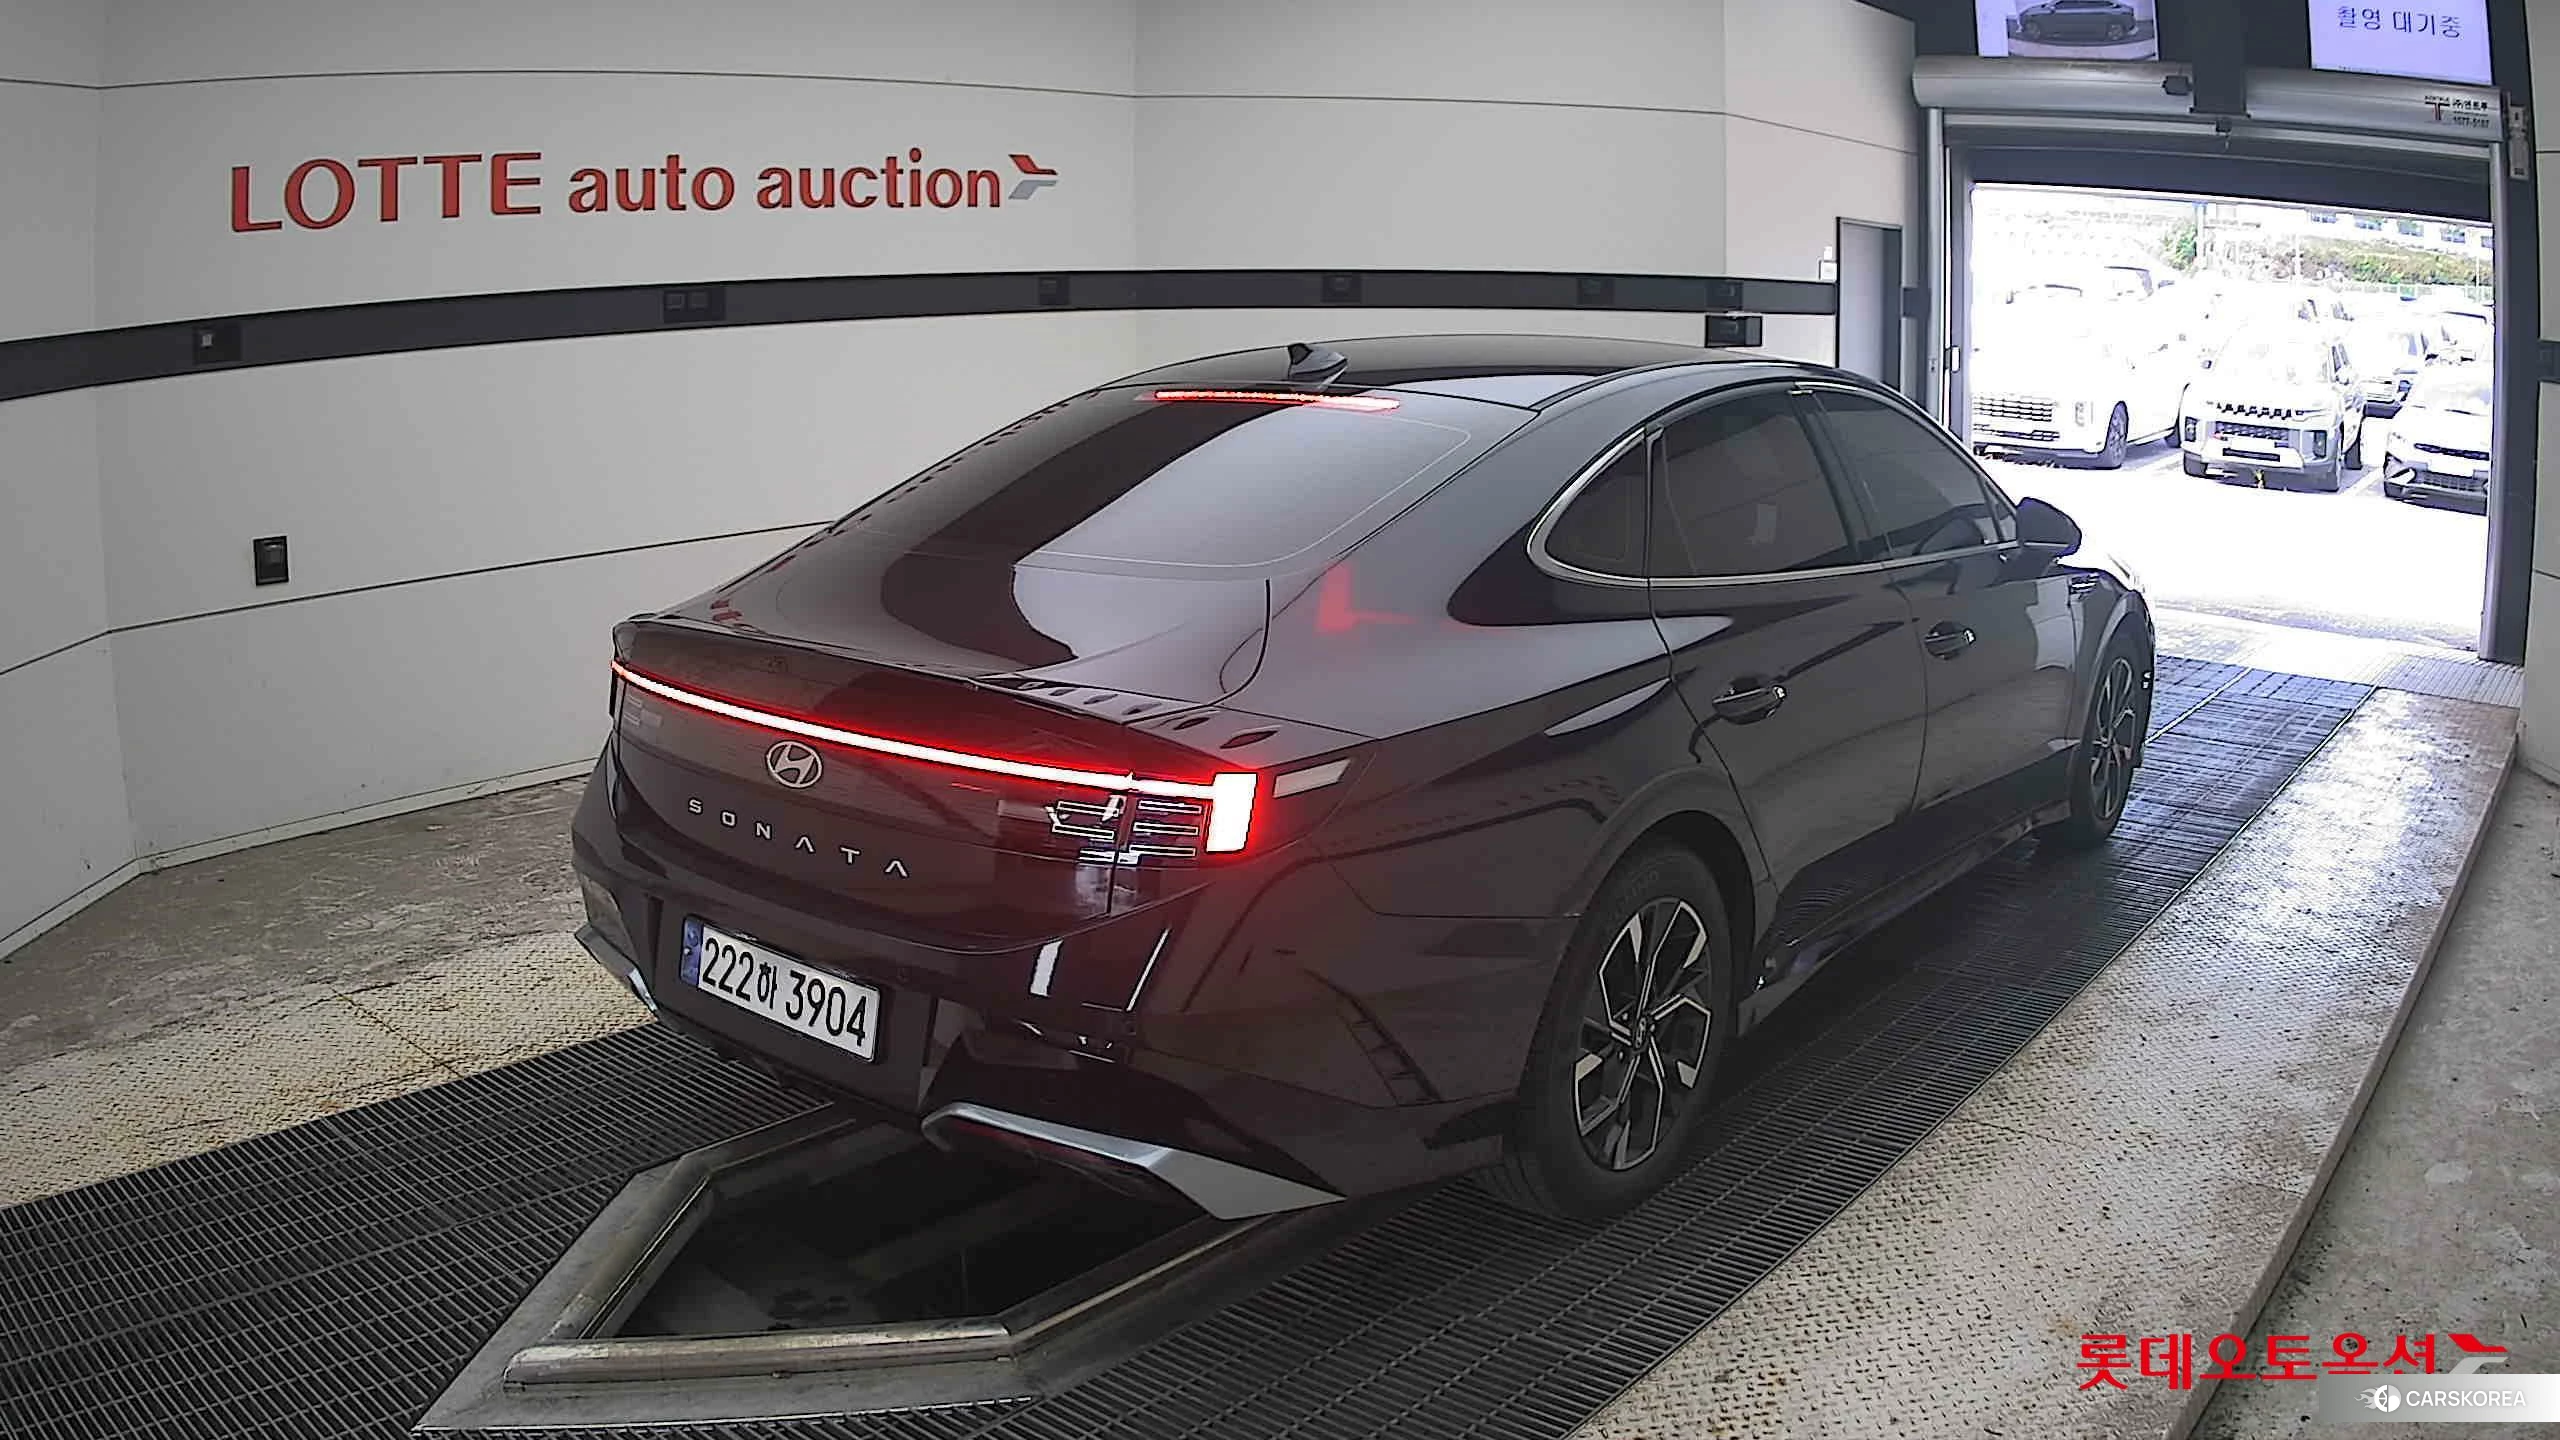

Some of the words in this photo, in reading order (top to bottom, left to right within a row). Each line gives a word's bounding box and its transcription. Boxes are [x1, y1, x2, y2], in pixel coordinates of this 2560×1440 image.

[2338, 5, 2382, 31] 촬영
[2392, 11, 2463, 39] 대기중
[232, 152, 541, 233] LOTTE
[569, 154, 735, 213] auto
[757, 147, 1001, 209] auction
[688, 799, 908, 878] SONATA
[702, 937, 777, 1010] 222하
[785, 969, 867, 1047] 3904
